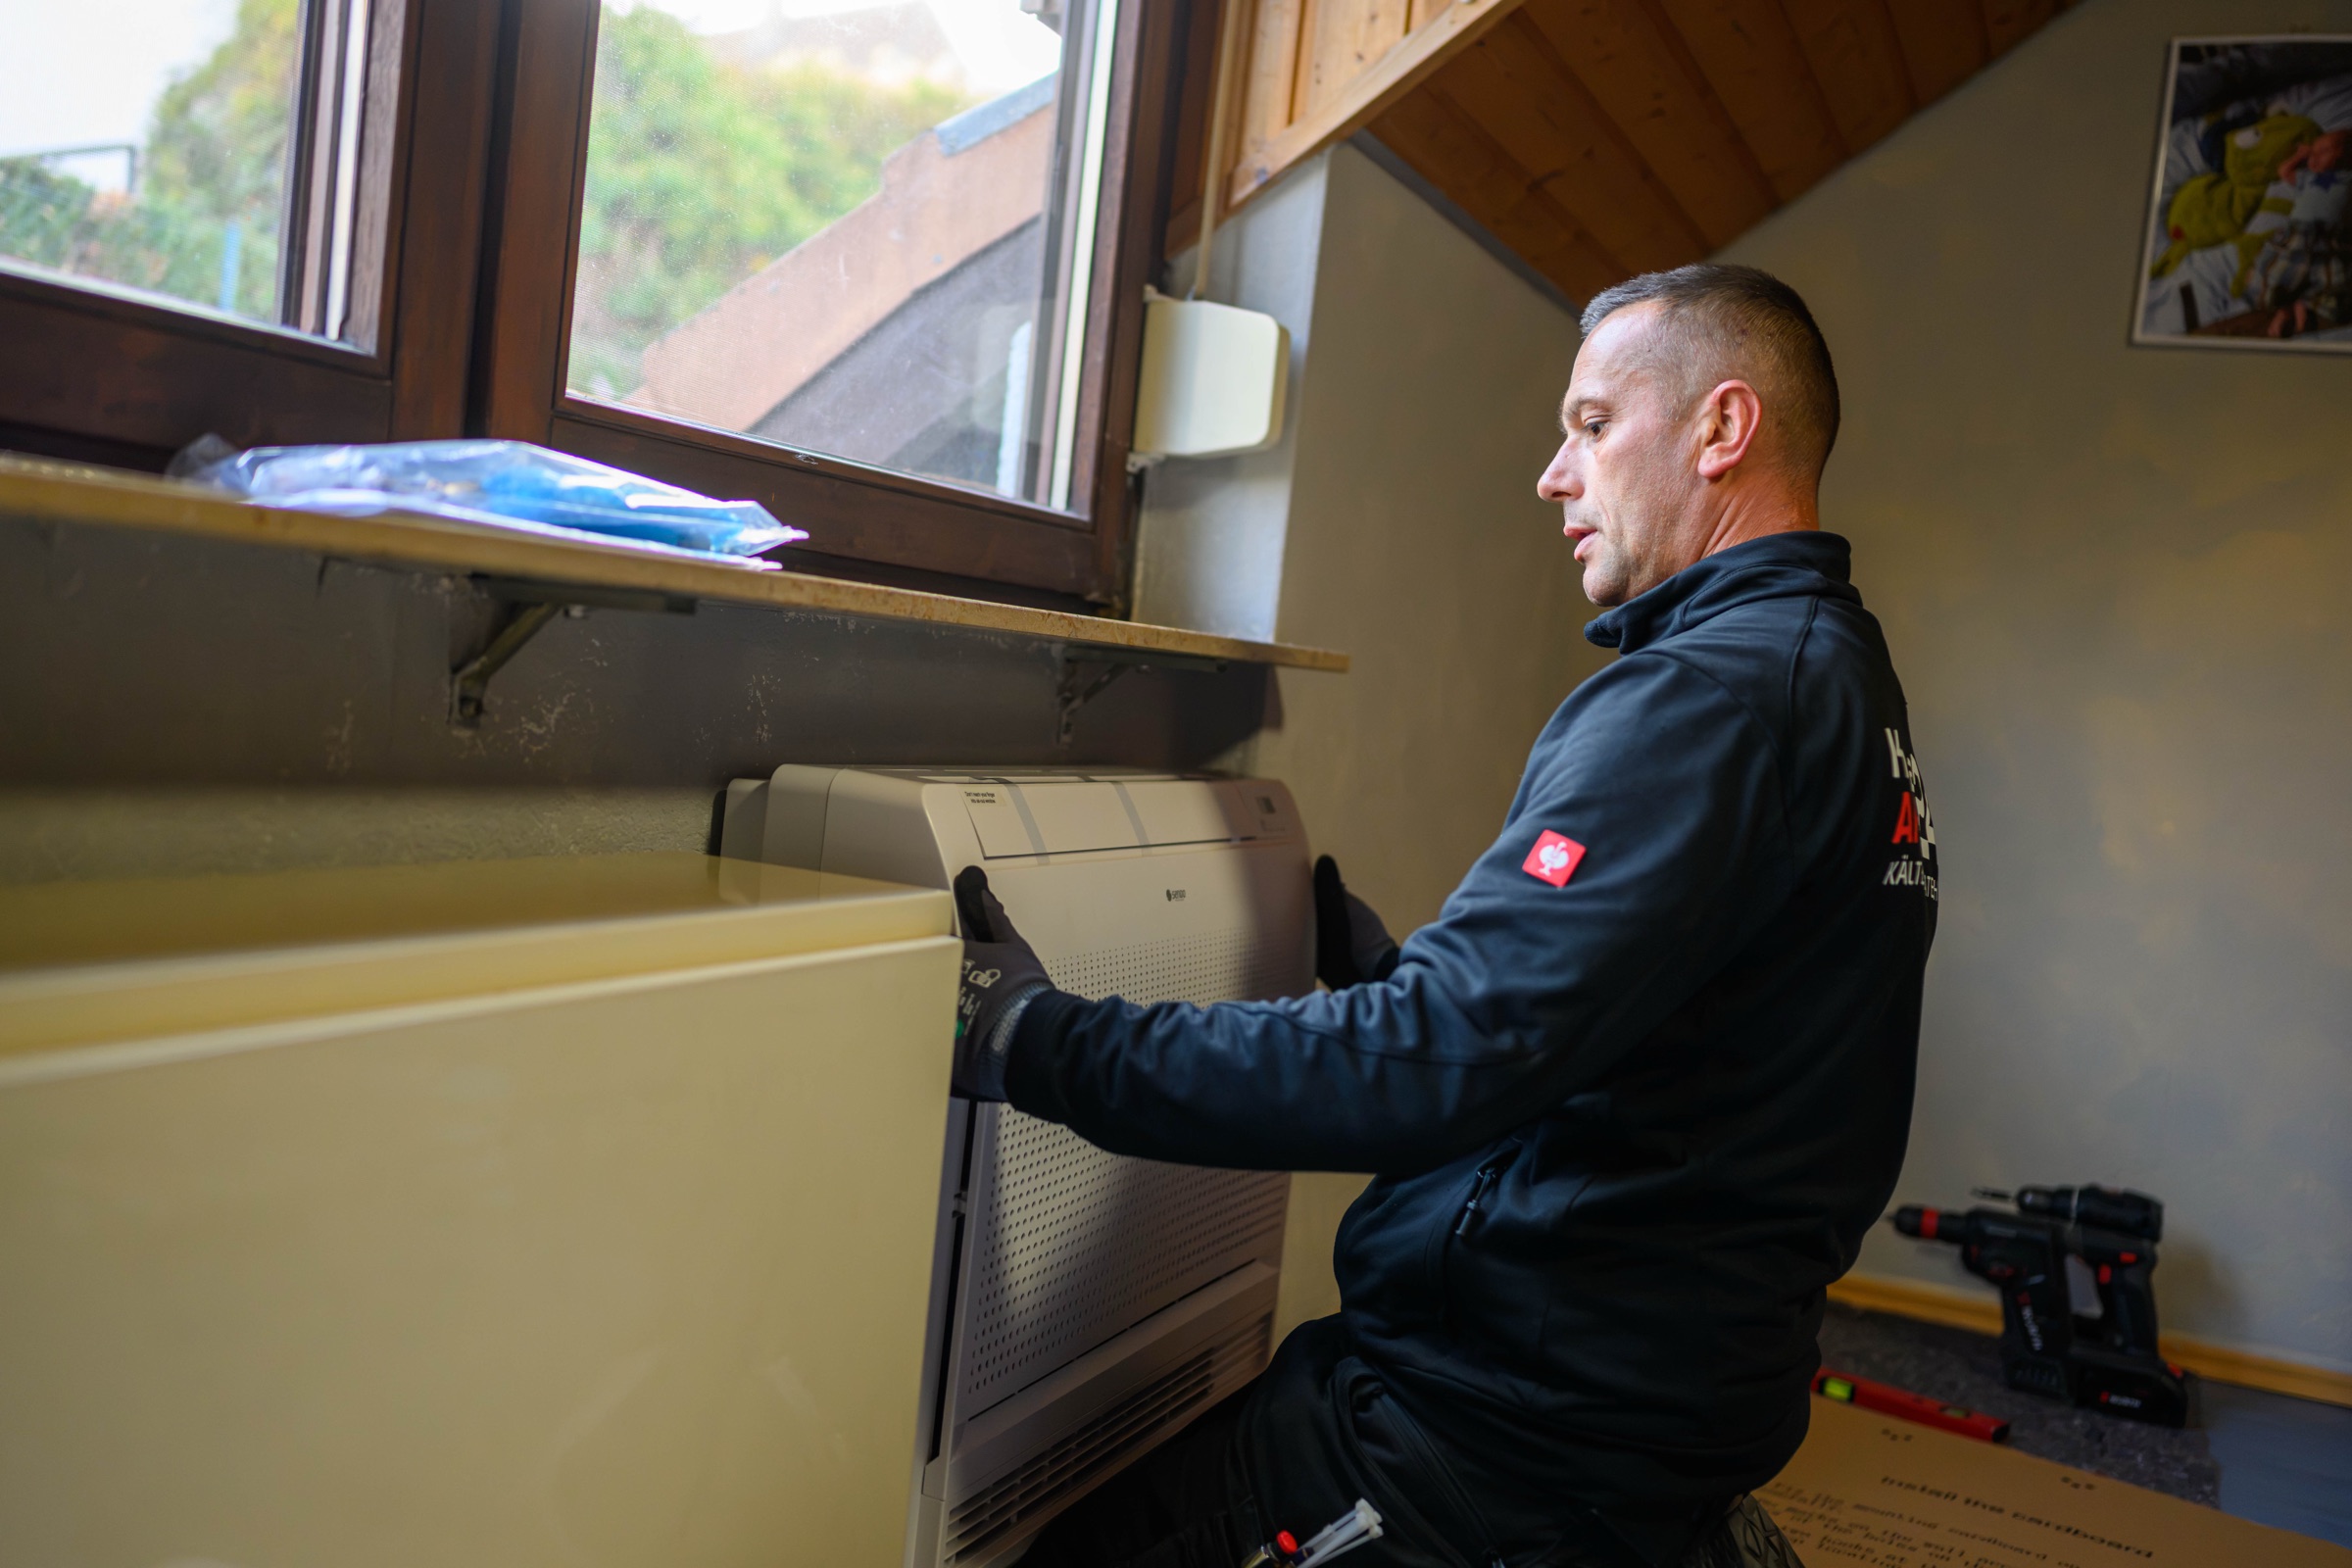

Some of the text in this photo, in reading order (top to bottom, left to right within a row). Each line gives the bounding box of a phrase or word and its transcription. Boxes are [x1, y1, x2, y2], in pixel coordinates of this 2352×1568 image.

[1881, 1476, 2153, 1559] Install the cardboard
